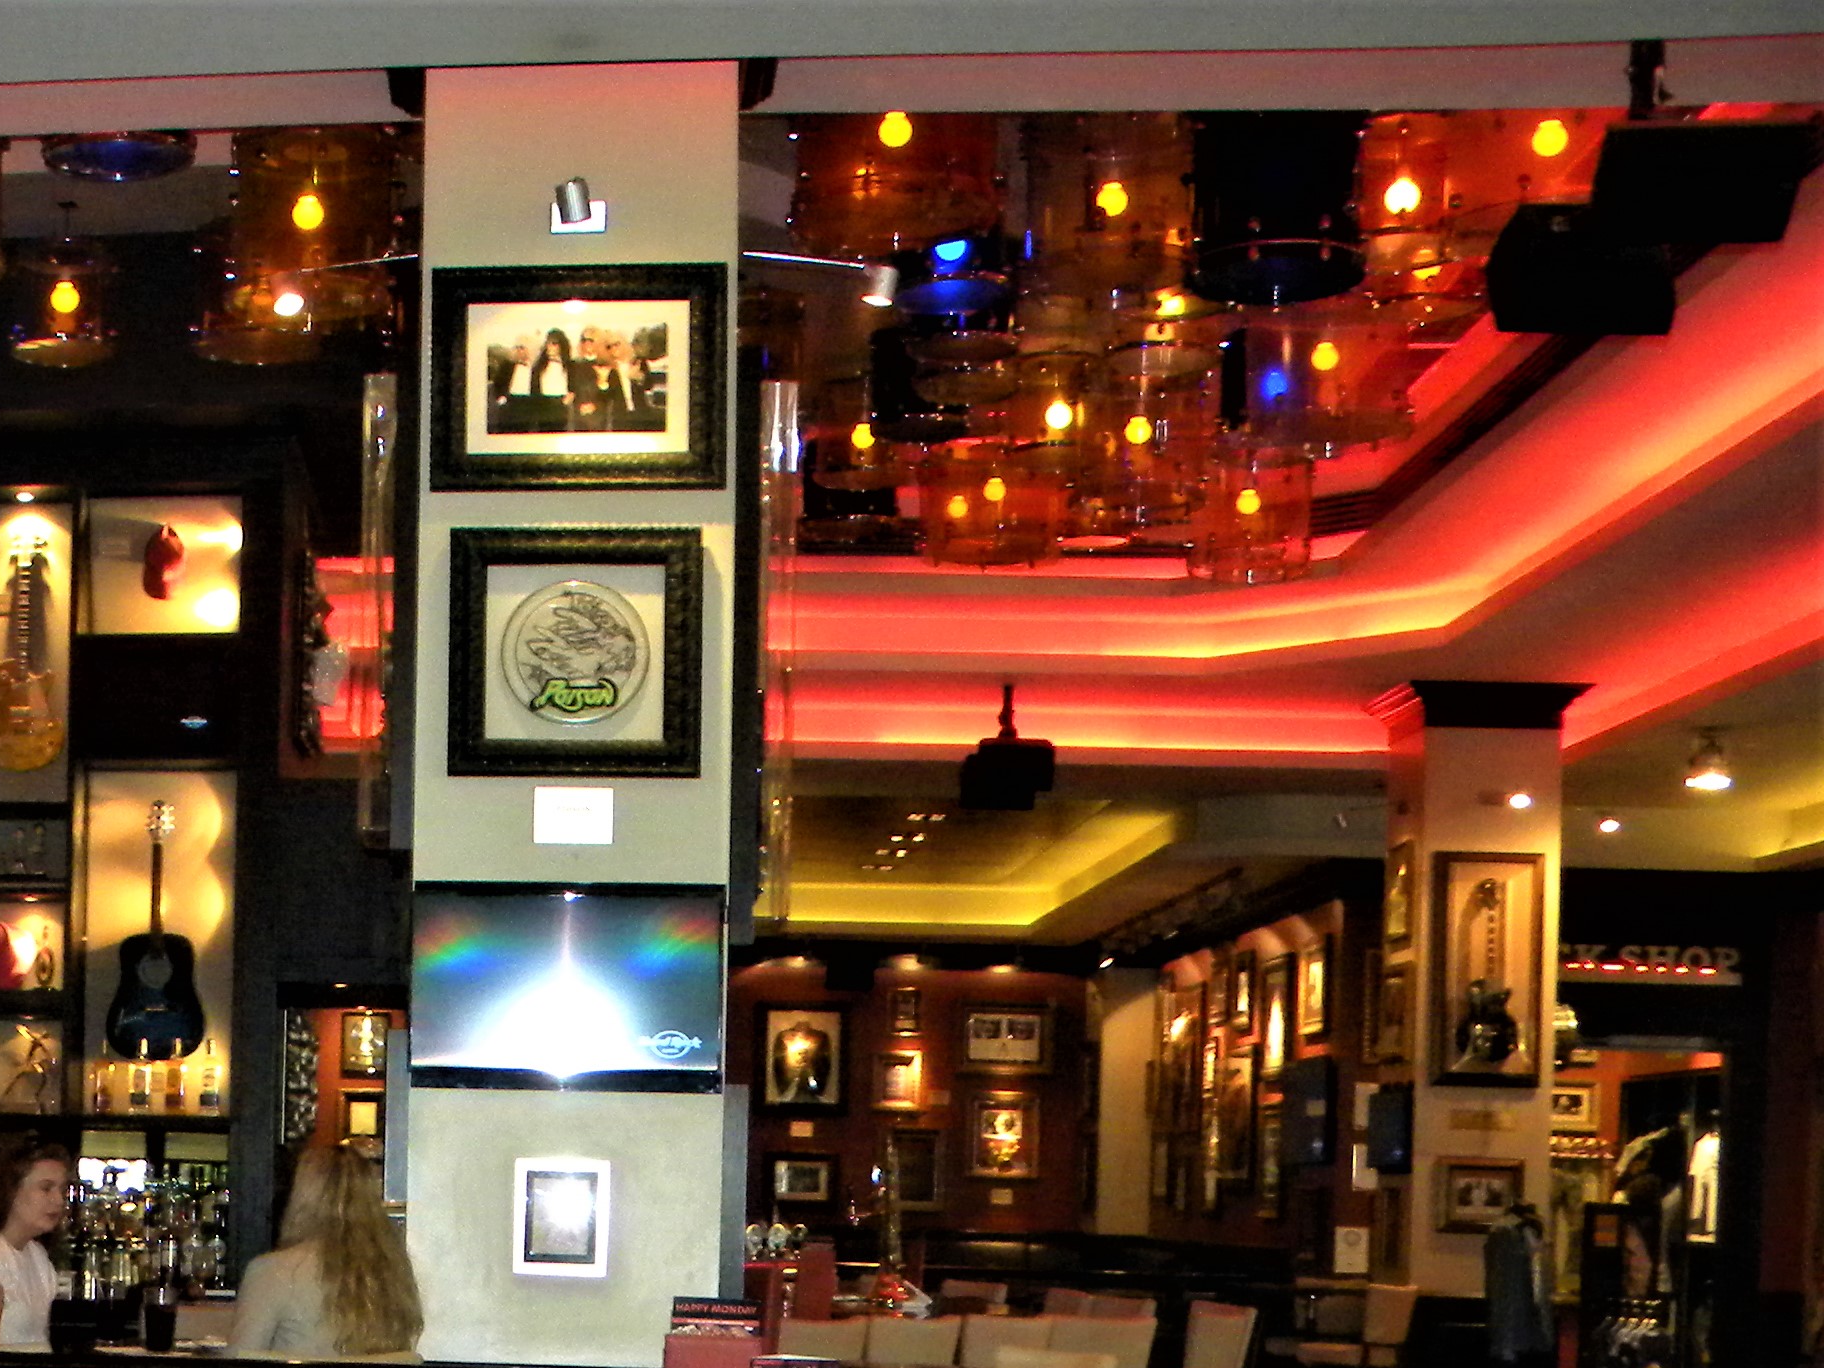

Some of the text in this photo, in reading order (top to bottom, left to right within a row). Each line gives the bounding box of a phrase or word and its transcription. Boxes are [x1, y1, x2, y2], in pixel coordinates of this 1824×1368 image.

[1619, 944, 1741, 972] SHOP
[675, 1303, 757, 1315] HAPPY MONDAY
